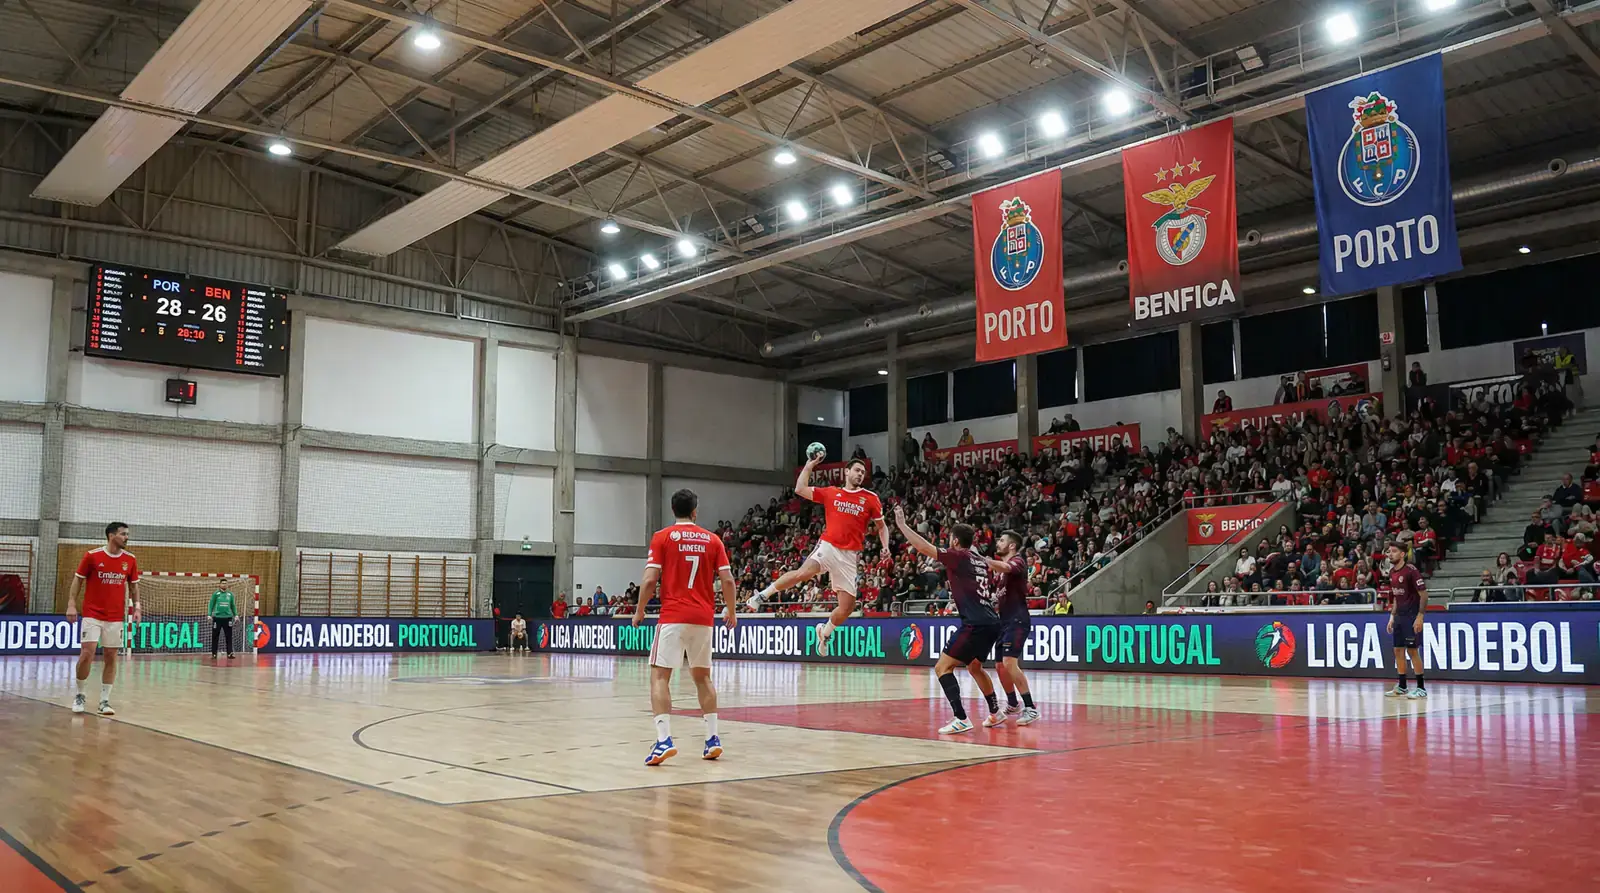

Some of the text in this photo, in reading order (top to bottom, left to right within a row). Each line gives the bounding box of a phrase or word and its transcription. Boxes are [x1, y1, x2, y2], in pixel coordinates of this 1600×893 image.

[1334, 214, 1440, 273] PORTO
[153, 279, 180, 293] POR
[205, 286, 231, 300] BEN
[1134, 279, 1236, 321] BENFICA
[156, 297, 182, 317] 28
[201, 303, 227, 323] 26
[984, 300, 1053, 344] PORTO
[177, 328, 205, 340] 28:10
[953, 446, 1005, 469] BENFIC
[1221, 518, 1270, 532] BENFIC
[685, 555, 700, 589] 7
[276, 623, 478, 648] LIGA ANDEBOL PORTUGAL
[550, 625, 571, 648] LIGA
[572, 625, 616, 650] ANDEBOL
[711, 625, 736, 654] IGA
[738, 625, 802, 656] ANDEBOL
[1086, 624, 1221, 666] PORTUGAL
[1306, 620, 1585, 673] LIGA NDEBOL
